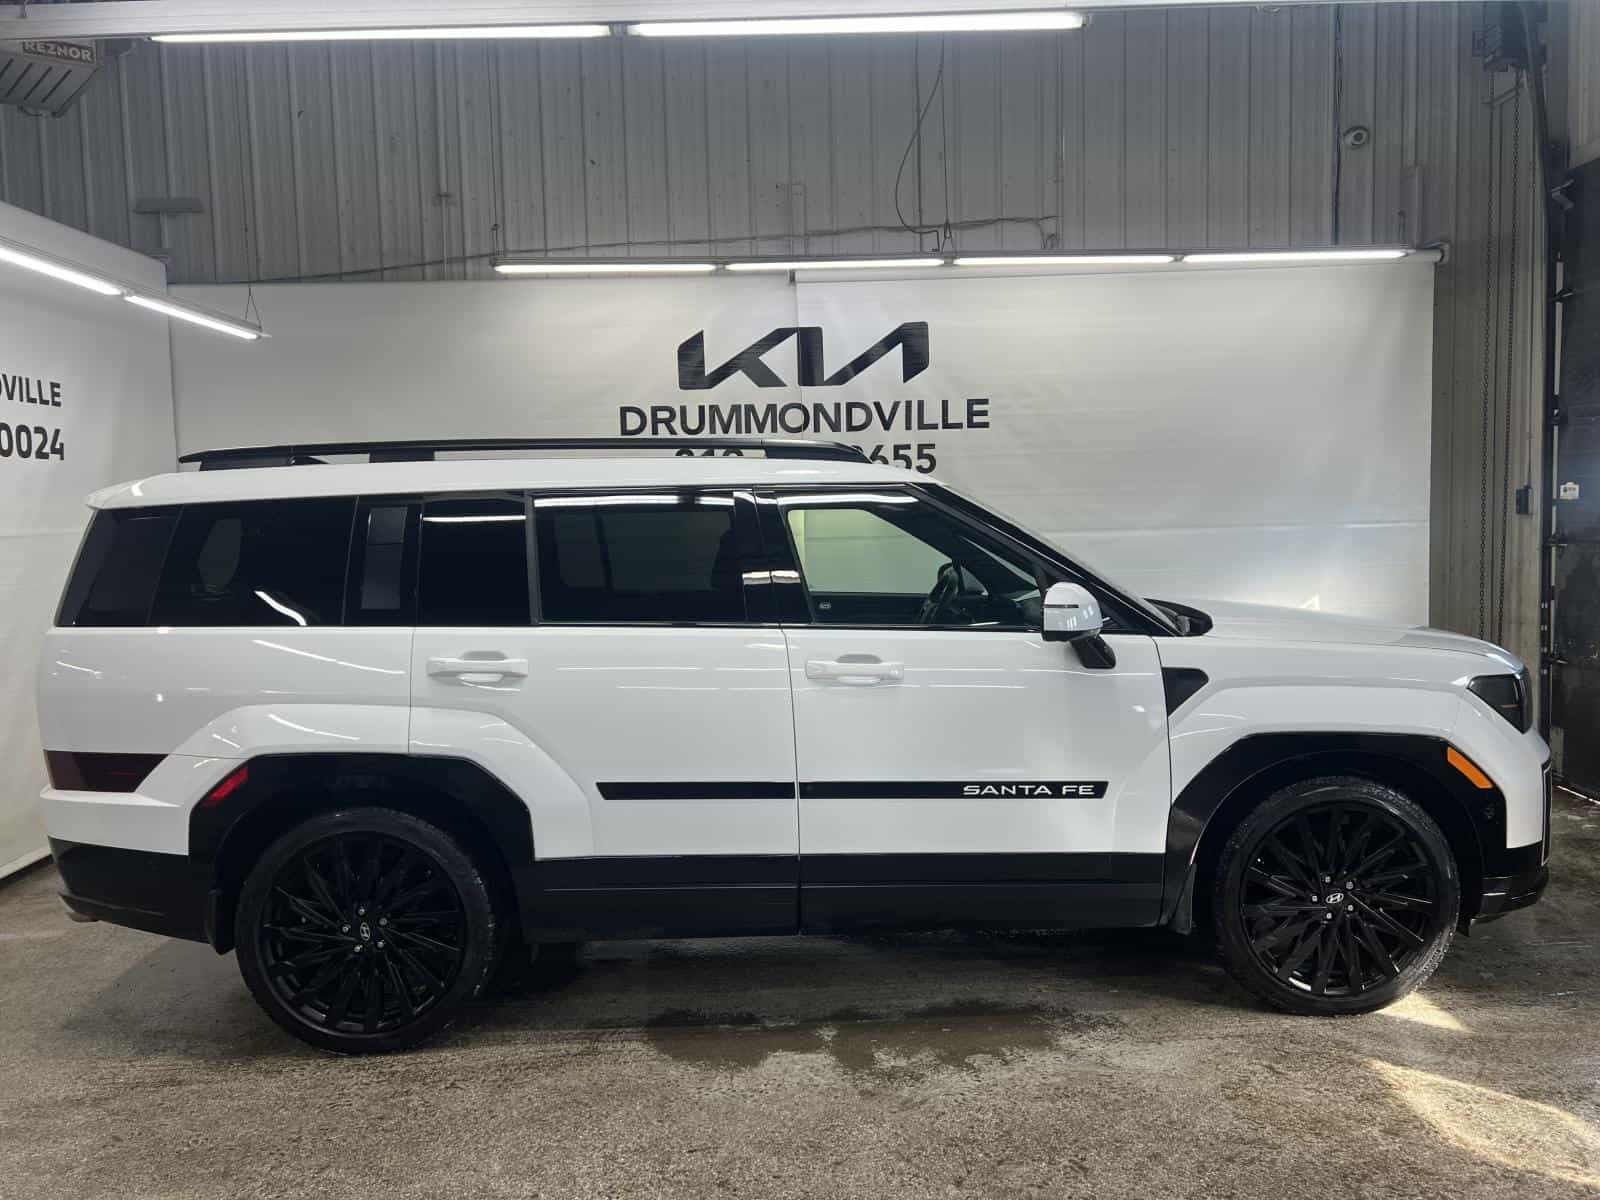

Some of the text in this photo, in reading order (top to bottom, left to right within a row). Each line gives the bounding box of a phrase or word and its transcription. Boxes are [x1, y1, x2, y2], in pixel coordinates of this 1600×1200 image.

[24, 41, 92, 61] REZNOR
[677, 321, 929, 390] KIA
[0, 373, 62, 407] VILLE
[619, 398, 990, 436] DRUMMONDVILLE
[851, 443, 936, 474] 655
[963, 785, 1095, 795] SANTA FE
